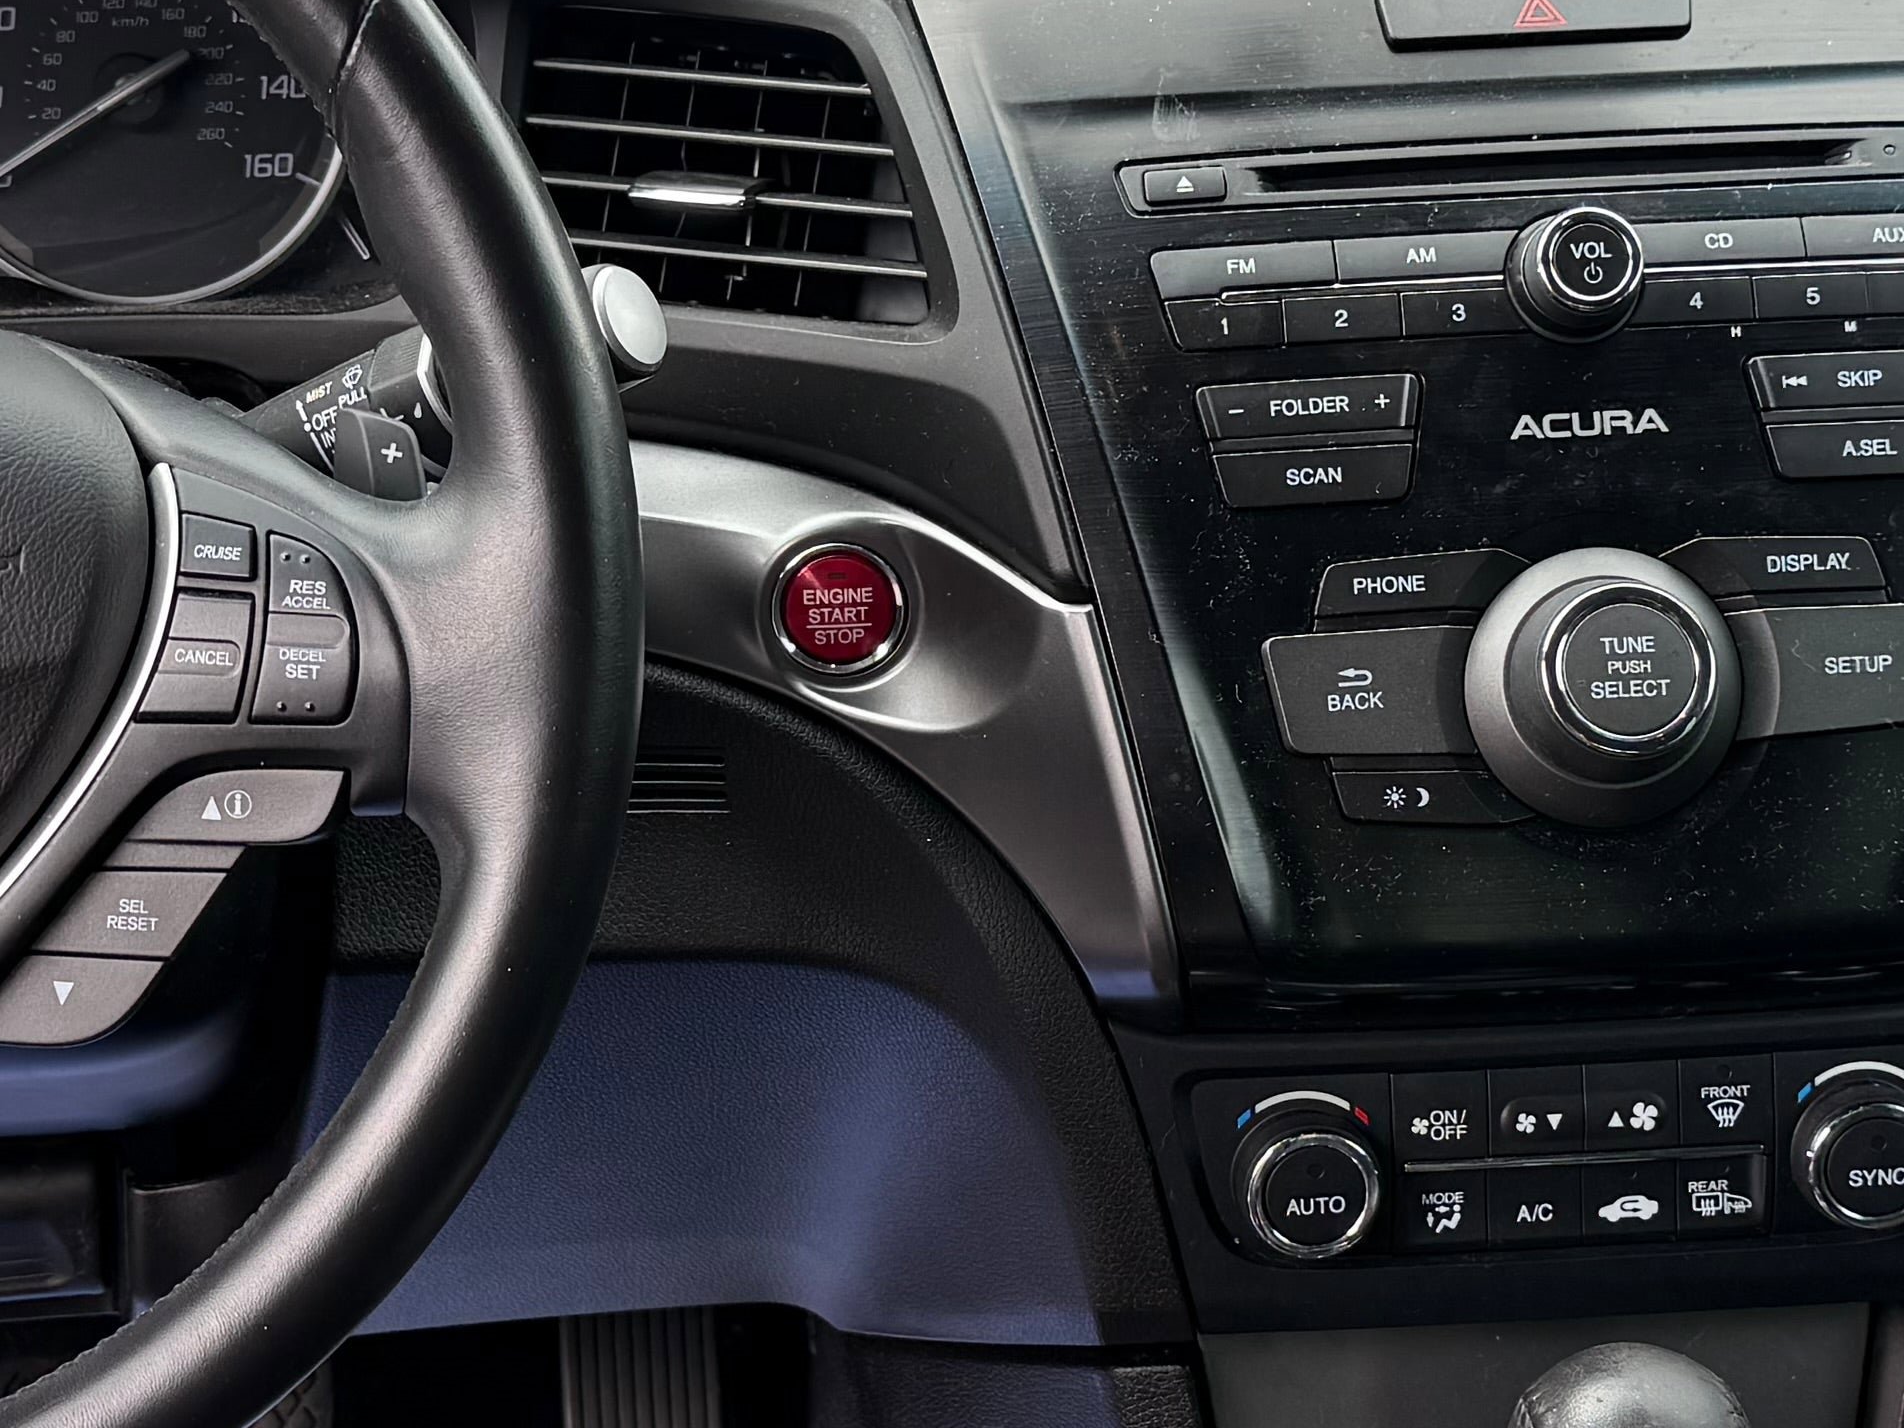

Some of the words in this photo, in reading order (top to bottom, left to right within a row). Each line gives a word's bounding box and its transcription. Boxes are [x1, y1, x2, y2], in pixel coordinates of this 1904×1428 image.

[76, 11, 99, 24] 100
[111, 15, 150, 27] km/h
[161, 8, 185, 21] 160
[55, 30, 76, 44] 80
[43, 53, 63, 66] 60
[37, 79, 56, 92] 40
[41, 107, 62, 120] 20
[244, 152, 295, 179] 160
[1704, 233, 1734, 249] CD
[1406, 247, 1437, 264] AM
[1570, 242, 1613, 260] VOL
[1226, 258, 1256, 275] FM
[1689, 292, 1703, 310] 4
[1806, 287, 1821, 305] 5
[1334, 310, 1349, 328] 2
[1451, 303, 1467, 322] 3
[1219, 317, 1230, 335] 1
[1730, 326, 1742, 338] H
[1844, 321, 1857, 333] M
[1836, 370, 1883, 388] SKIP
[305, 381, 333, 404] MIST
[338, 386, 368, 410] PULL
[1269, 395, 1350, 418] FOLDER
[1509, 408, 1670, 440] ACURA
[1842, 439, 1898, 457] A.SEL
[1285, 466, 1343, 485] SCAN
[193, 543, 242, 562] CRUISE
[1766, 551, 1850, 573] DISPLAY
[289, 578, 327, 596] RES
[1352, 574, 1426, 595] PHONE
[281, 596, 331, 611] ACCEL
[802, 586, 874, 605] ENGINE
[808, 606, 868, 624] START
[814, 628, 865, 645] STOP
[1599, 635, 1656, 655] TUNE
[173, 648, 234, 666] CANCEL
[278, 647, 327, 662] DECEL
[284, 664, 321, 680] SET
[1607, 660, 1652, 675] PUSH
[1824, 654, 1893, 674] SETUP
[1590, 678, 1671, 700] SELECT
[1326, 691, 1385, 712] BACK
[118, 899, 149, 914] SEL
[106, 915, 159, 932] RESET
[1700, 1084, 1751, 1099] FRONT
[1429, 1108, 1467, 1126] ON/
[1429, 1126, 1468, 1142] OFF
[1687, 1179, 1729, 1194] REAR
[1285, 1195, 1346, 1217] AUTO
[1421, 1191, 1465, 1205] MODE
[1516, 1203, 1554, 1223] A/C
